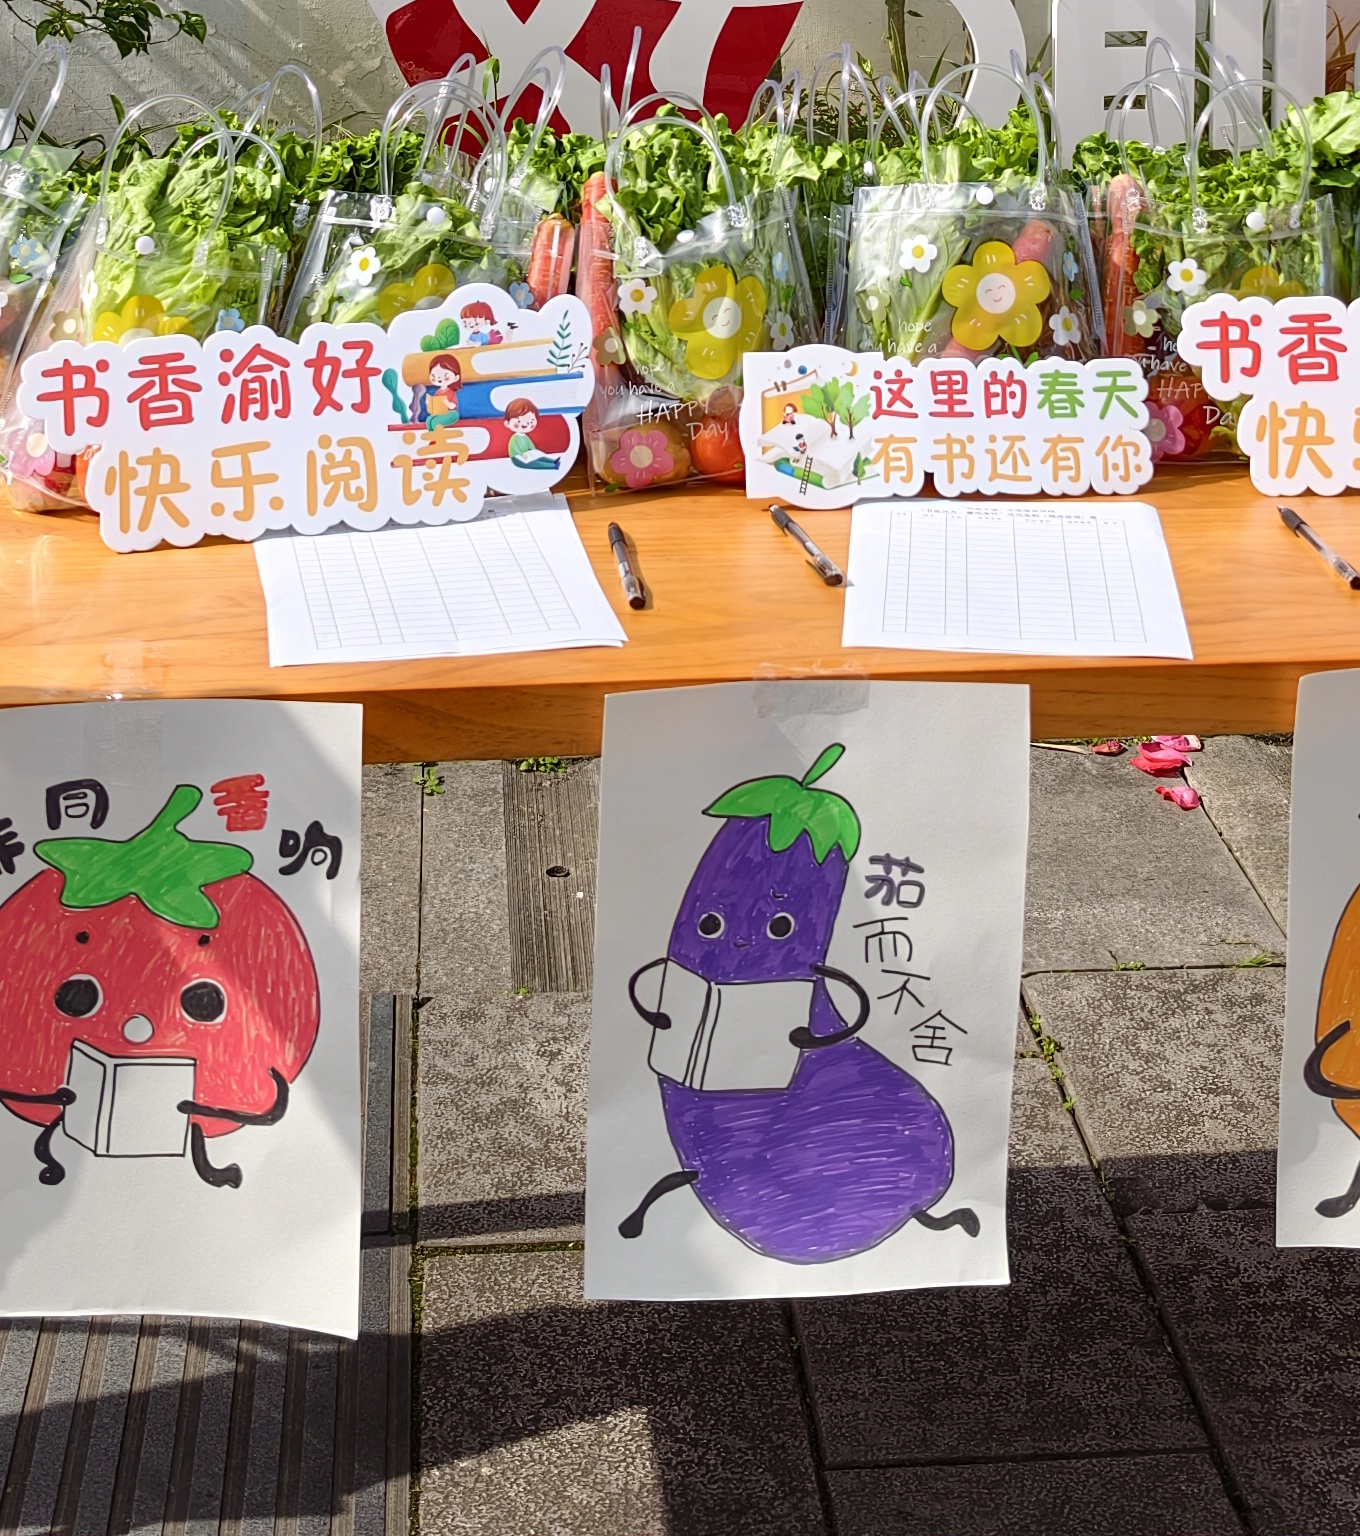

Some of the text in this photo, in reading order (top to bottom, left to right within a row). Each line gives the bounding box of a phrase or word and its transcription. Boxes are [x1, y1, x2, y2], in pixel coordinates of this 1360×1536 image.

[887, 337, 923, 353] have
[927, 342, 937, 353] a
[36, 338, 382, 437] 书香渝好
[629, 381, 660, 395] have
[636, 397, 709, 425] HAPPY
[869, 368, 1140, 421] 这里的春天
[686, 421, 728, 446] Day
[872, 432, 1143, 485] 有书还有你
[103, 424, 472, 535] 快乐阅读
[853, 852, 968, 1066] 茄而不舍
